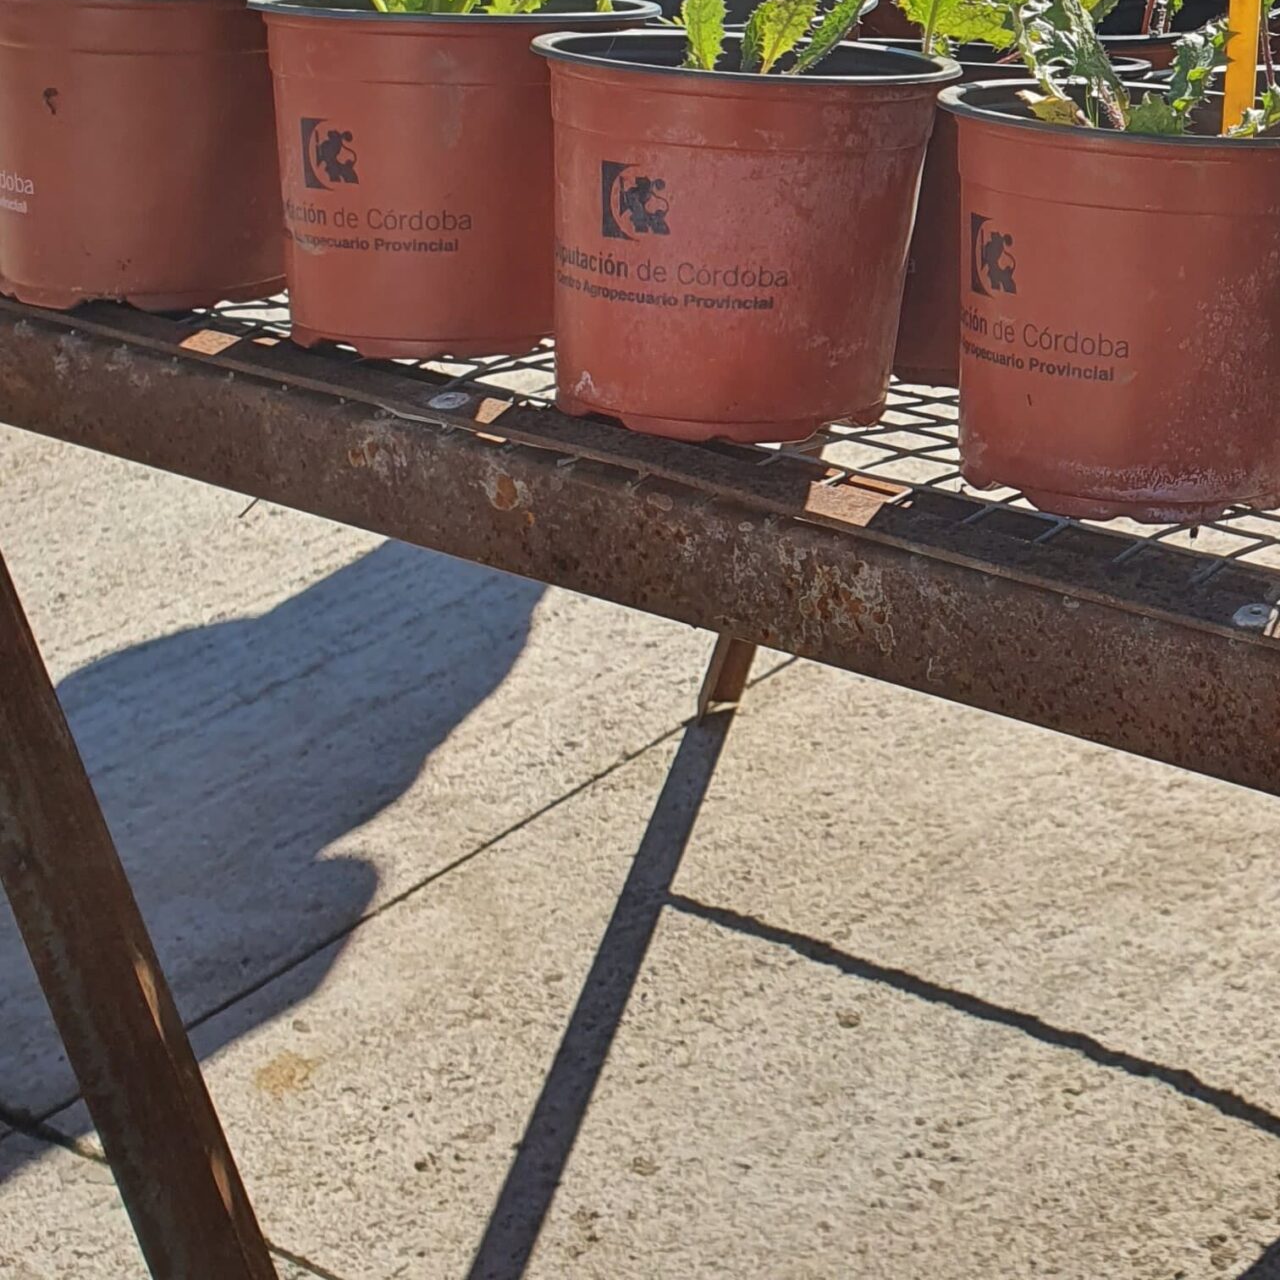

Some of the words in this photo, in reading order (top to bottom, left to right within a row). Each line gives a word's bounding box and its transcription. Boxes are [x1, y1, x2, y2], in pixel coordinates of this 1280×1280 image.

[0, 170, 34, 194] doba
[333, 205, 359, 229] de
[366, 207, 472, 231] Córdoba
[373, 236, 459, 254] Provincial
[636, 258, 668, 284] de
[677, 261, 789, 289] Córdoba
[582, 280, 679, 308] Agropecuario
[683, 294, 774, 310] Provincial
[993, 319, 1016, 344] de
[1023, 323, 1130, 359] Córdoba
[1028, 356, 1115, 382] Provincial
